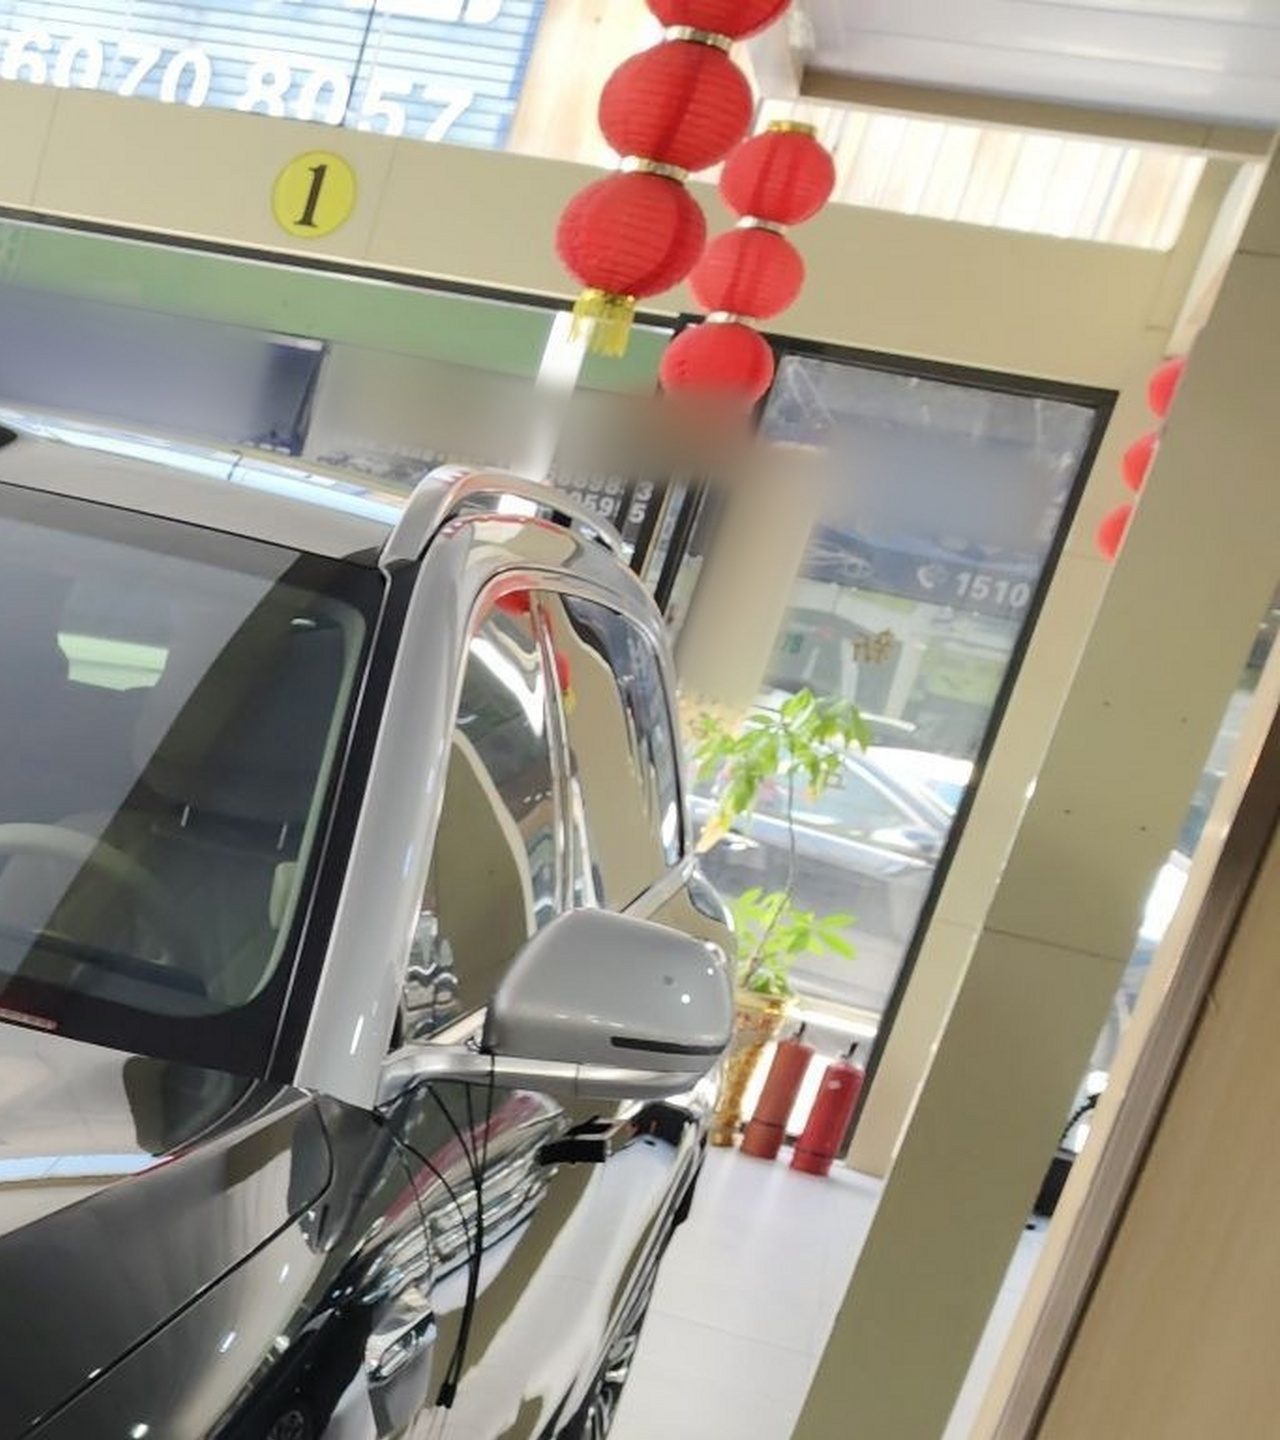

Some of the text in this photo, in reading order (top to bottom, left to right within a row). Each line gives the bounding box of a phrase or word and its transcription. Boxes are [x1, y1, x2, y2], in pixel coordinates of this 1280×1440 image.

[0, 28, 215, 108] 6070
[236, 55, 475, 143] 8057
[293, 163, 328, 228] 1
[955, 571, 1031, 610] 1510
